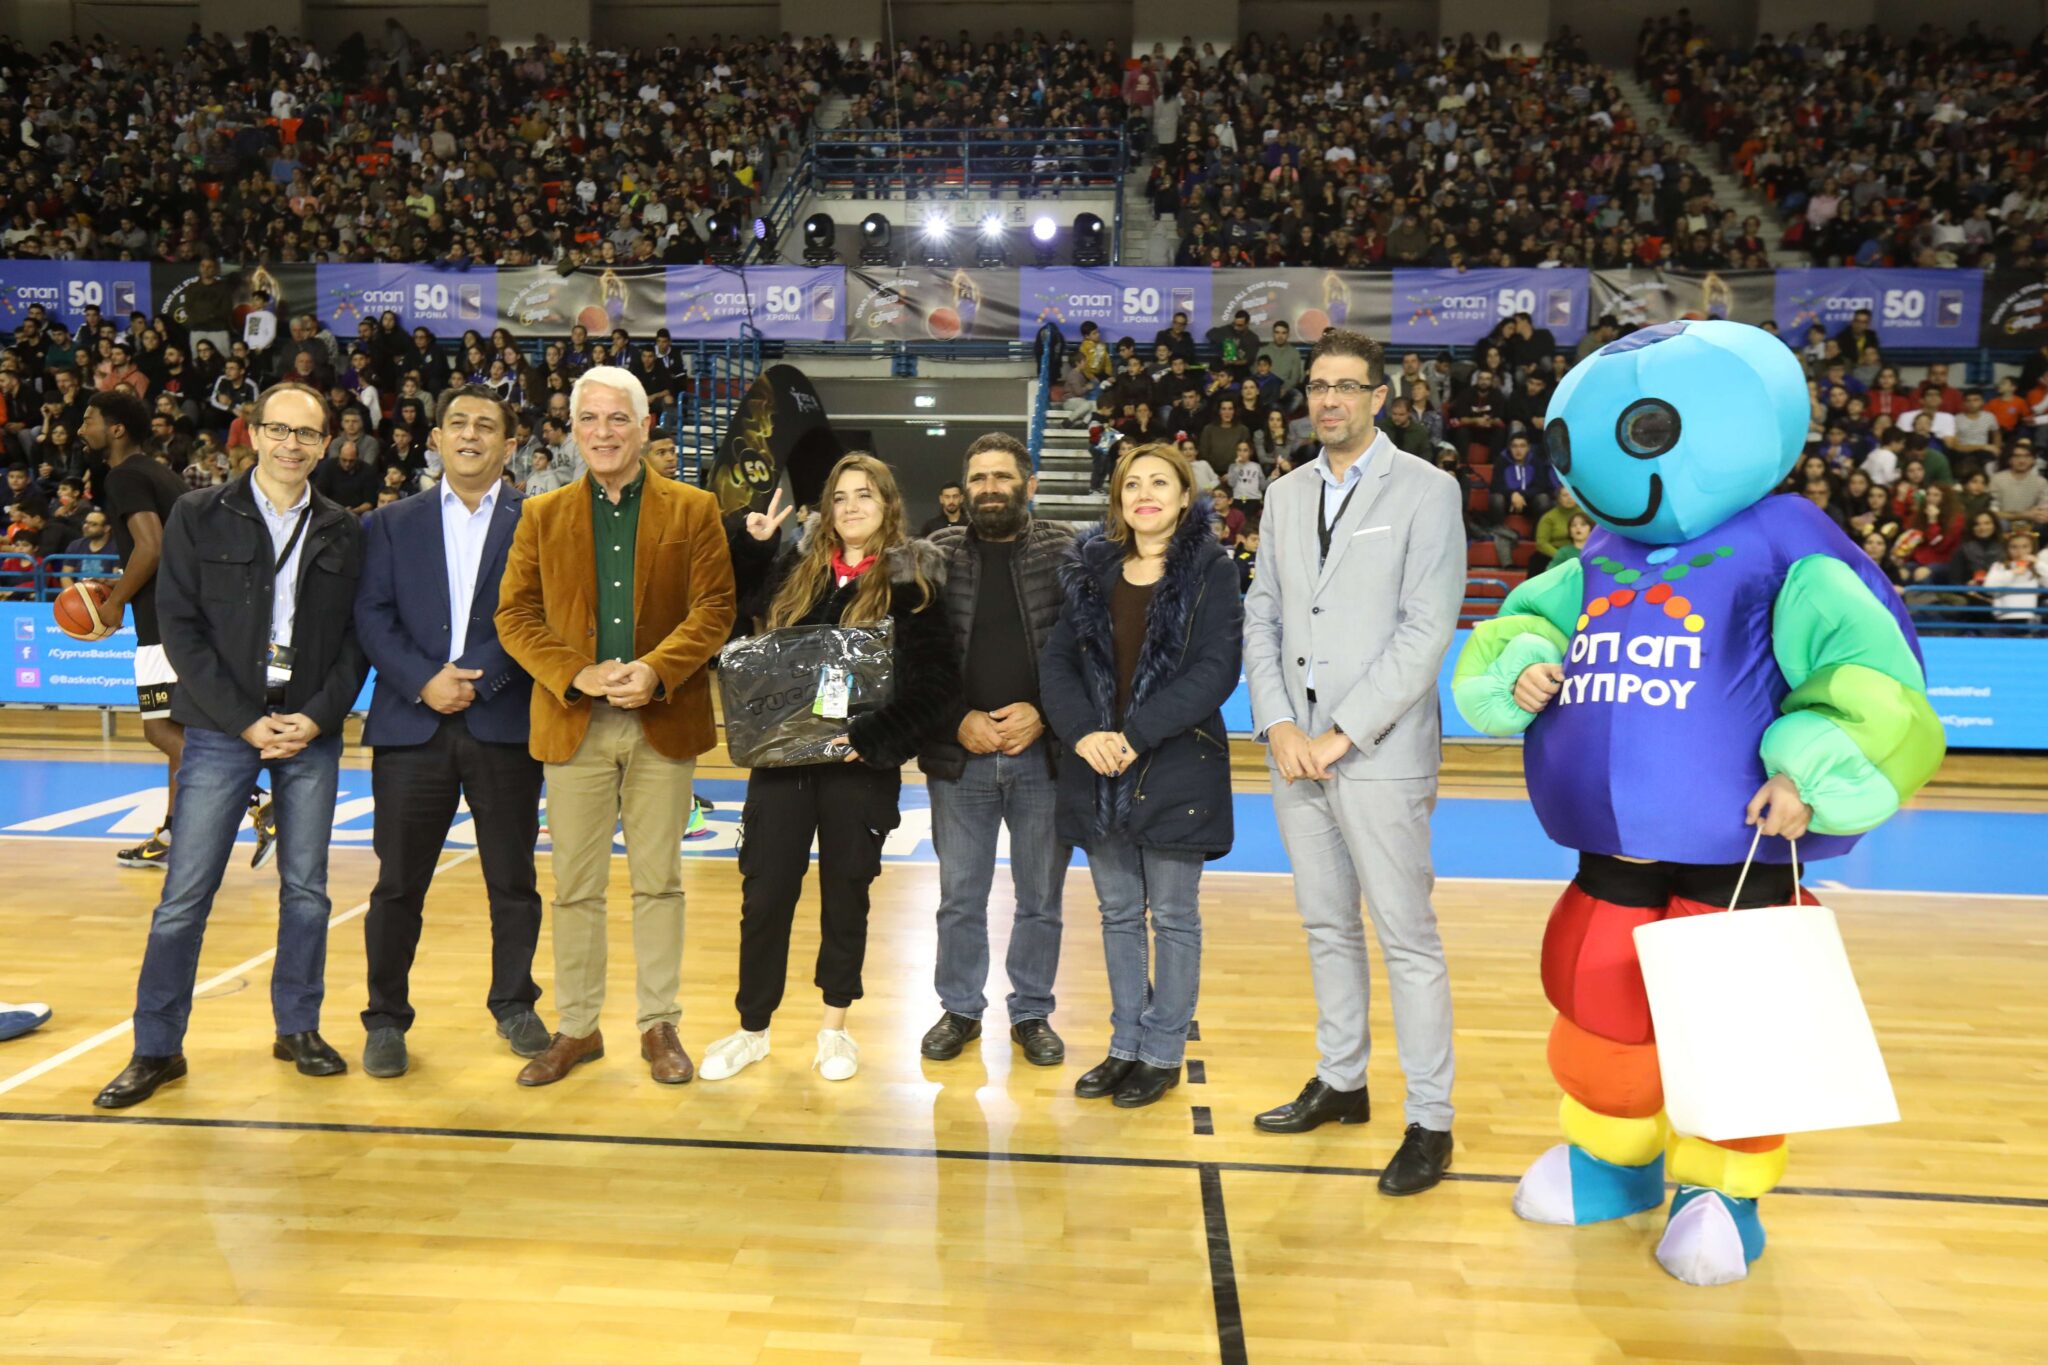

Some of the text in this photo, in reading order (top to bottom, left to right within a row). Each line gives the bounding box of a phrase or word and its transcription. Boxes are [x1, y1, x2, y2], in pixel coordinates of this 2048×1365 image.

[18, 302, 58, 310] ΚΥΟΥ
[68, 280, 103, 307] 50
[414, 284, 448, 310] 50
[766, 286, 801, 313] 50
[1122, 287, 1160, 315] 50
[1497, 289, 1536, 318] 50
[1883, 289, 1925, 319] 50
[1068, 309, 1112, 318] ΚΥΠΡΟΥ
[1442, 311, 1486, 320] ΚΥΠΡΟΥ
[744, 460, 770, 484] 50
[50, 675, 134, 687] @BasketCyprus
[1559, 673, 1696, 709] ΚΥΠΡΟΥ
